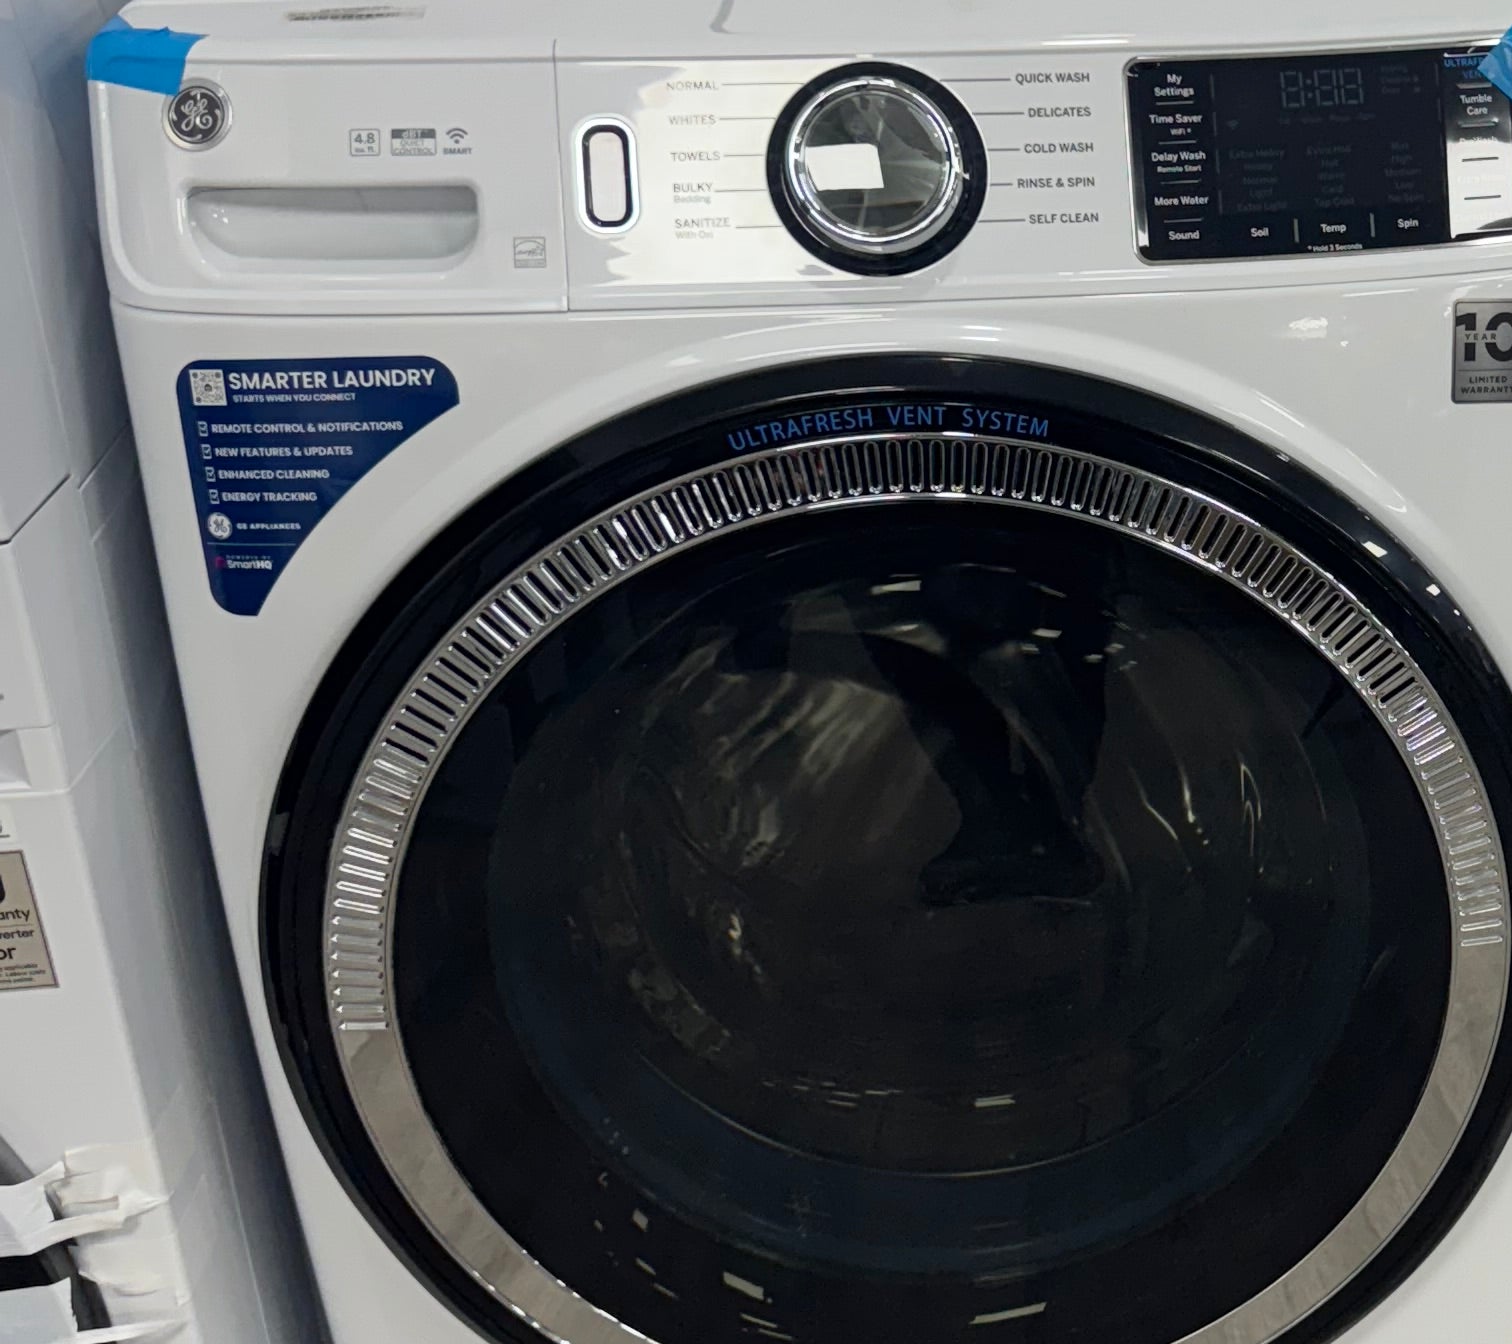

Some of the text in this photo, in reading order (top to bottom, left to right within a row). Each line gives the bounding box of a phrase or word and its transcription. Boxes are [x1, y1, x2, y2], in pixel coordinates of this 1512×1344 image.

[1015, 72, 1090, 85] QUICK WASH
[1167, 74, 1182, 85] My
[666, 80, 719, 91] NORMAL
[1154, 87, 1194, 98] Settings
[1460, 94, 1493, 104] Tumble
[1028, 107, 1091, 117] DELICATES
[1466, 106, 1489, 116] Care
[669, 114, 716, 126] WHITES
[1149, 114, 1202, 124] Time Saver
[354, 132, 375, 145] 4.8
[393, 147, 433, 155] CONTROL
[443, 147, 472, 155] SMART
[1024, 142, 1094, 154] COLD WASH
[670, 150, 720, 161] TOWELS
[1151, 150, 1206, 163] Delay Wash
[673, 182, 713, 193] BULKY
[1017, 177, 1095, 188] RINSE & SPIN
[1154, 195, 1209, 206] More Water
[674, 216, 731, 229] SANITIZE
[1029, 212, 1099, 224] SELF CLEAN
[1320, 223, 1347, 234] Temp
[1397, 218, 1419, 230] Spin
[1168, 230, 1200, 241] Sound
[1250, 227, 1269, 238] Soil
[1465, 333, 1496, 341] YEAR
[228, 368, 436, 391] SMARTER LAUNDRY
[1469, 376, 1508, 384] LIMITED
[233, 392, 356, 403] STARTS WHEN YOU CONNECT
[211, 421, 404, 434] REMOTE CONTROL & NOTIFICATIONS
[727, 404, 1050, 452] ULTRAFRESH VENT SYSTEM
[215, 445, 353, 457] NEW FEATURES & UPDATES
[218, 468, 330, 479] ENHANCED CLEANING
[221, 492, 317, 503] ENERGY TRACKING
[249, 522, 301, 530] APPLIANCES
